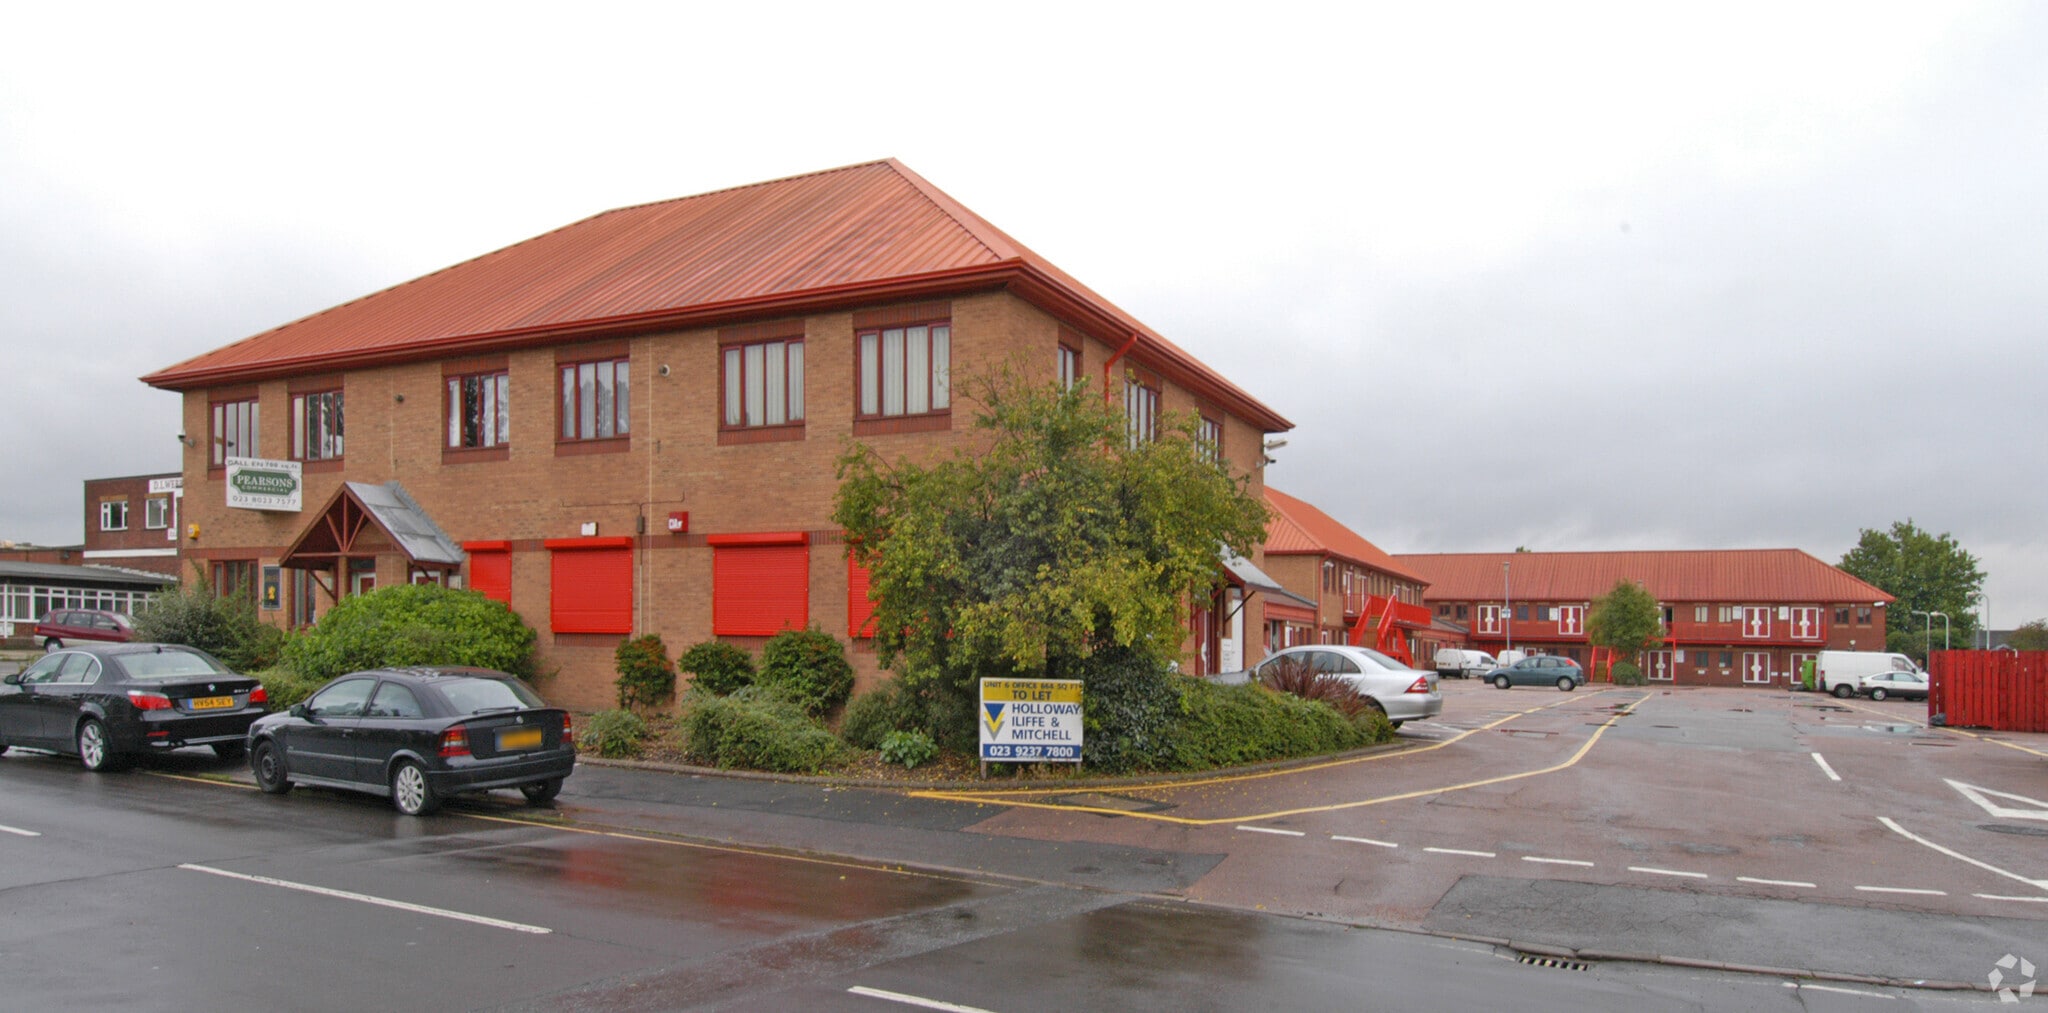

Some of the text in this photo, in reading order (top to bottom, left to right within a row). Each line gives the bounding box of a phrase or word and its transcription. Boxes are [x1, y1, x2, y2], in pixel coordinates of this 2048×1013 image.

[236, 474, 293, 488] PEARSONS
[1012, 690, 1052, 700] TO LET
[1012, 703, 1080, 714] HOLLOWAY
[1012, 716, 1060, 728] ILIFFE &
[1012, 729, 1072, 740] MITCHELL
[990, 746, 1074, 757] 023 9237 7800
